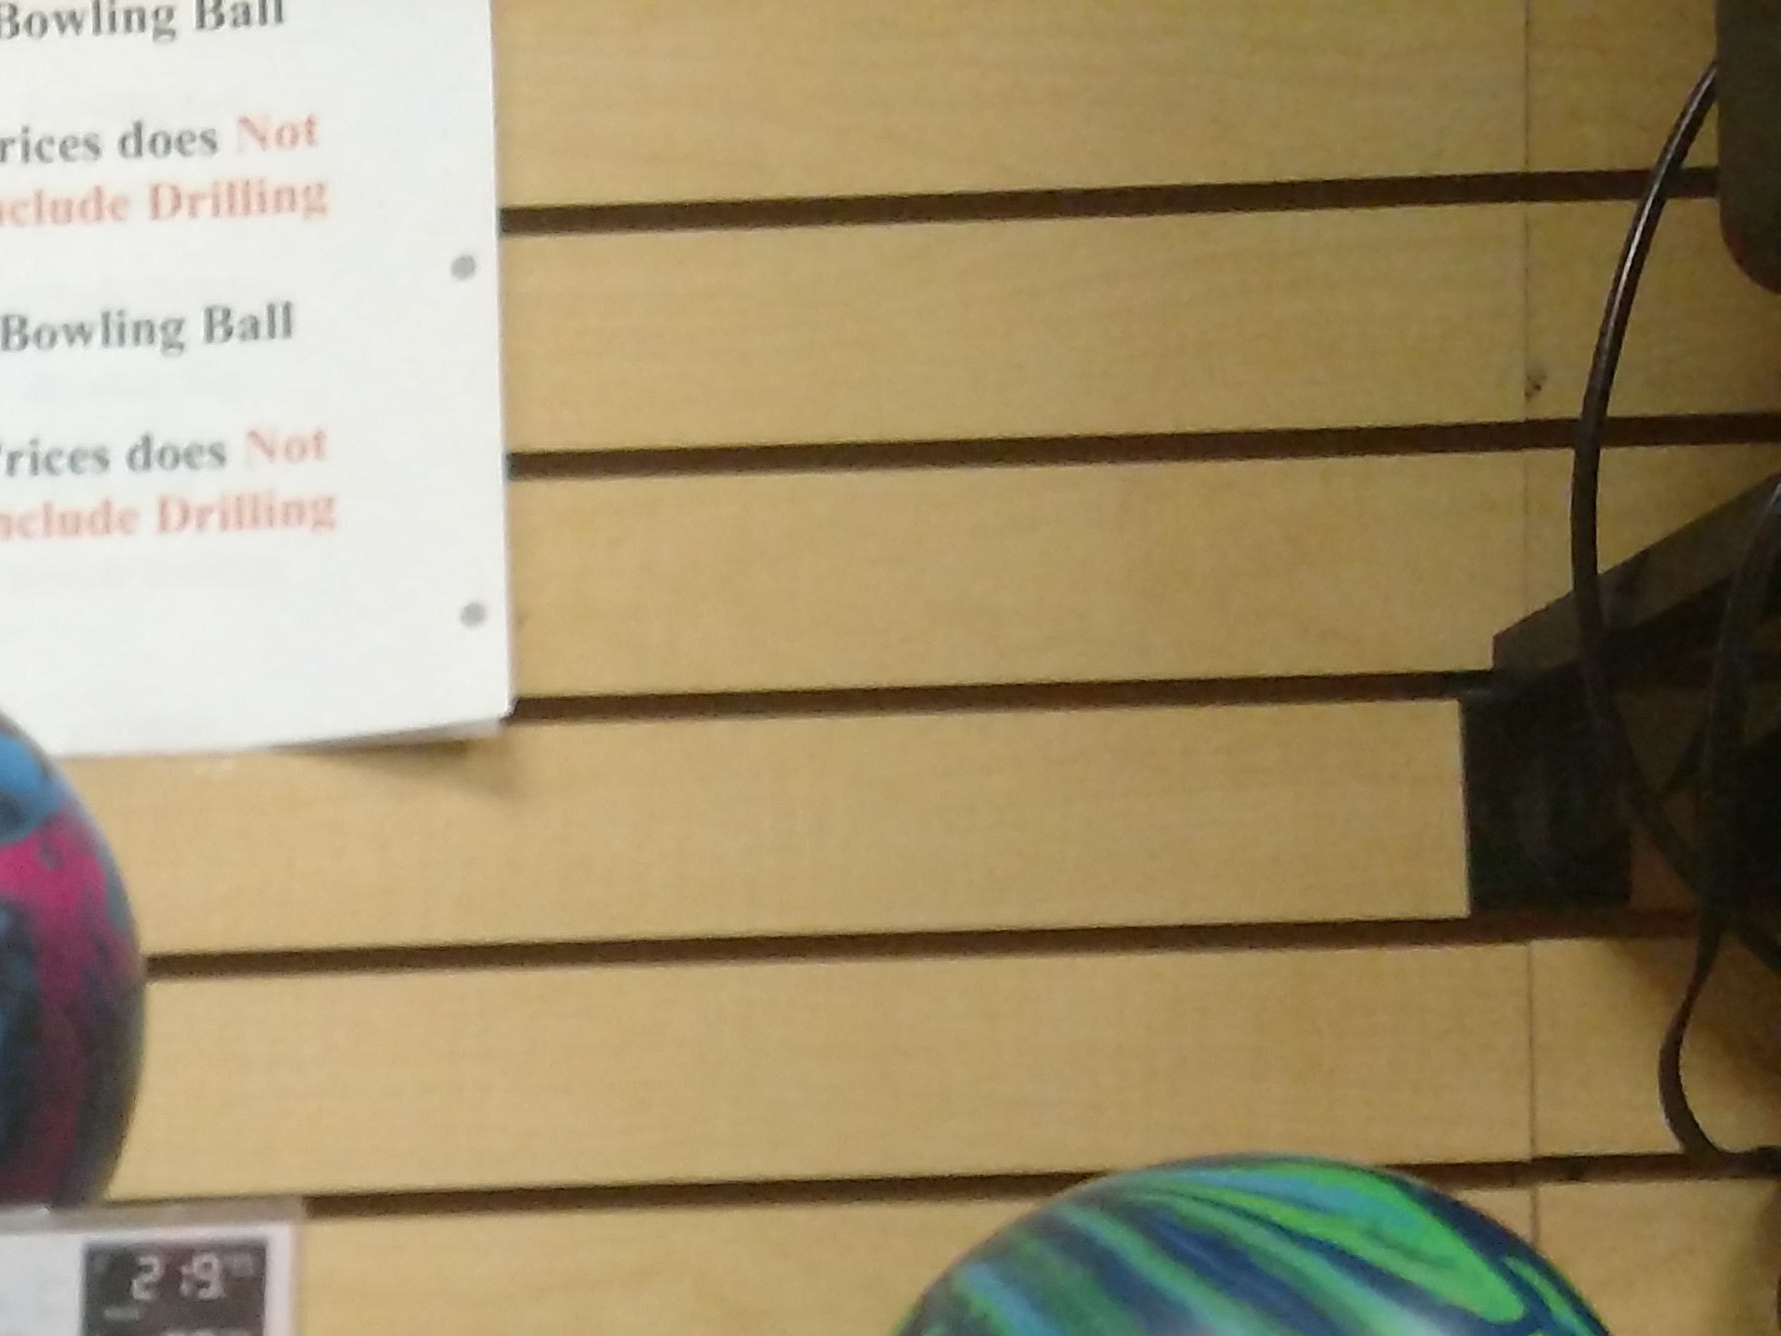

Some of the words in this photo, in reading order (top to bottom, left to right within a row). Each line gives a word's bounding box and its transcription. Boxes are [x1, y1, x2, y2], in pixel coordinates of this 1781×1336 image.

[195, 0, 284, 30] Ball
[119, 120, 218, 160] does
[236, 112, 319, 152] Not
[149, 177, 328, 224] Drilling
[202, 301, 295, 345] Ball
[126, 433, 227, 474] does
[245, 426, 328, 464] Not
[157, 491, 336, 536] Drilling
